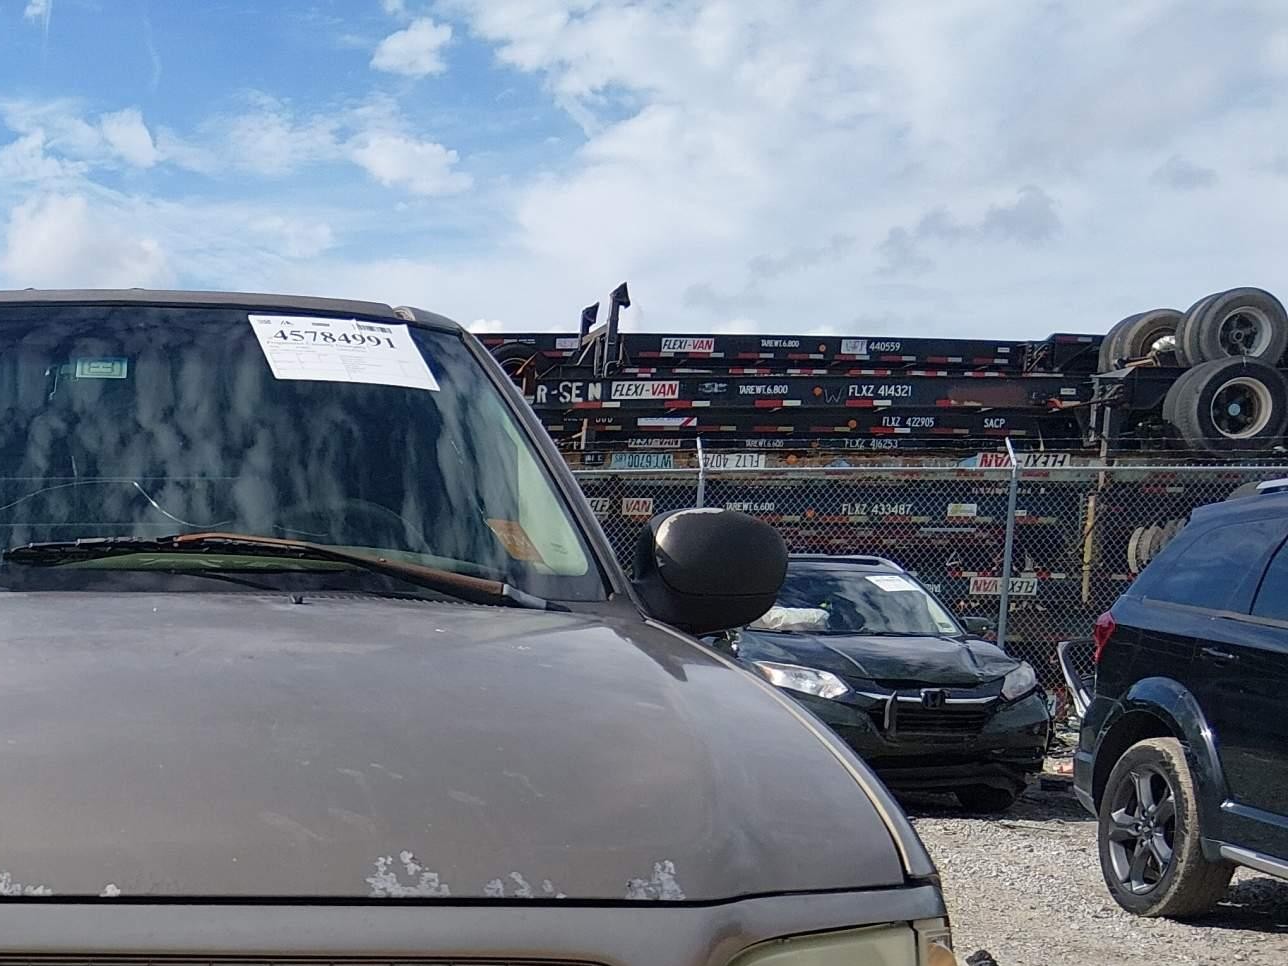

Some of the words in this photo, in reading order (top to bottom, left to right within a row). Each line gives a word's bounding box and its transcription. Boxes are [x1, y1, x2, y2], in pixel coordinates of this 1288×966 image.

[273, 329, 397, 350] 45784991
[869, 341, 901, 352] 440559
[613, 382, 678, 397] FLEXI-VAN
[848, 385, 874, 397] FLXZ
[878, 385, 912, 397] 414321
[984, 417, 1006, 429] SACP
[841, 503, 867, 515] FLXZ
[871, 503, 912, 516] 433487
